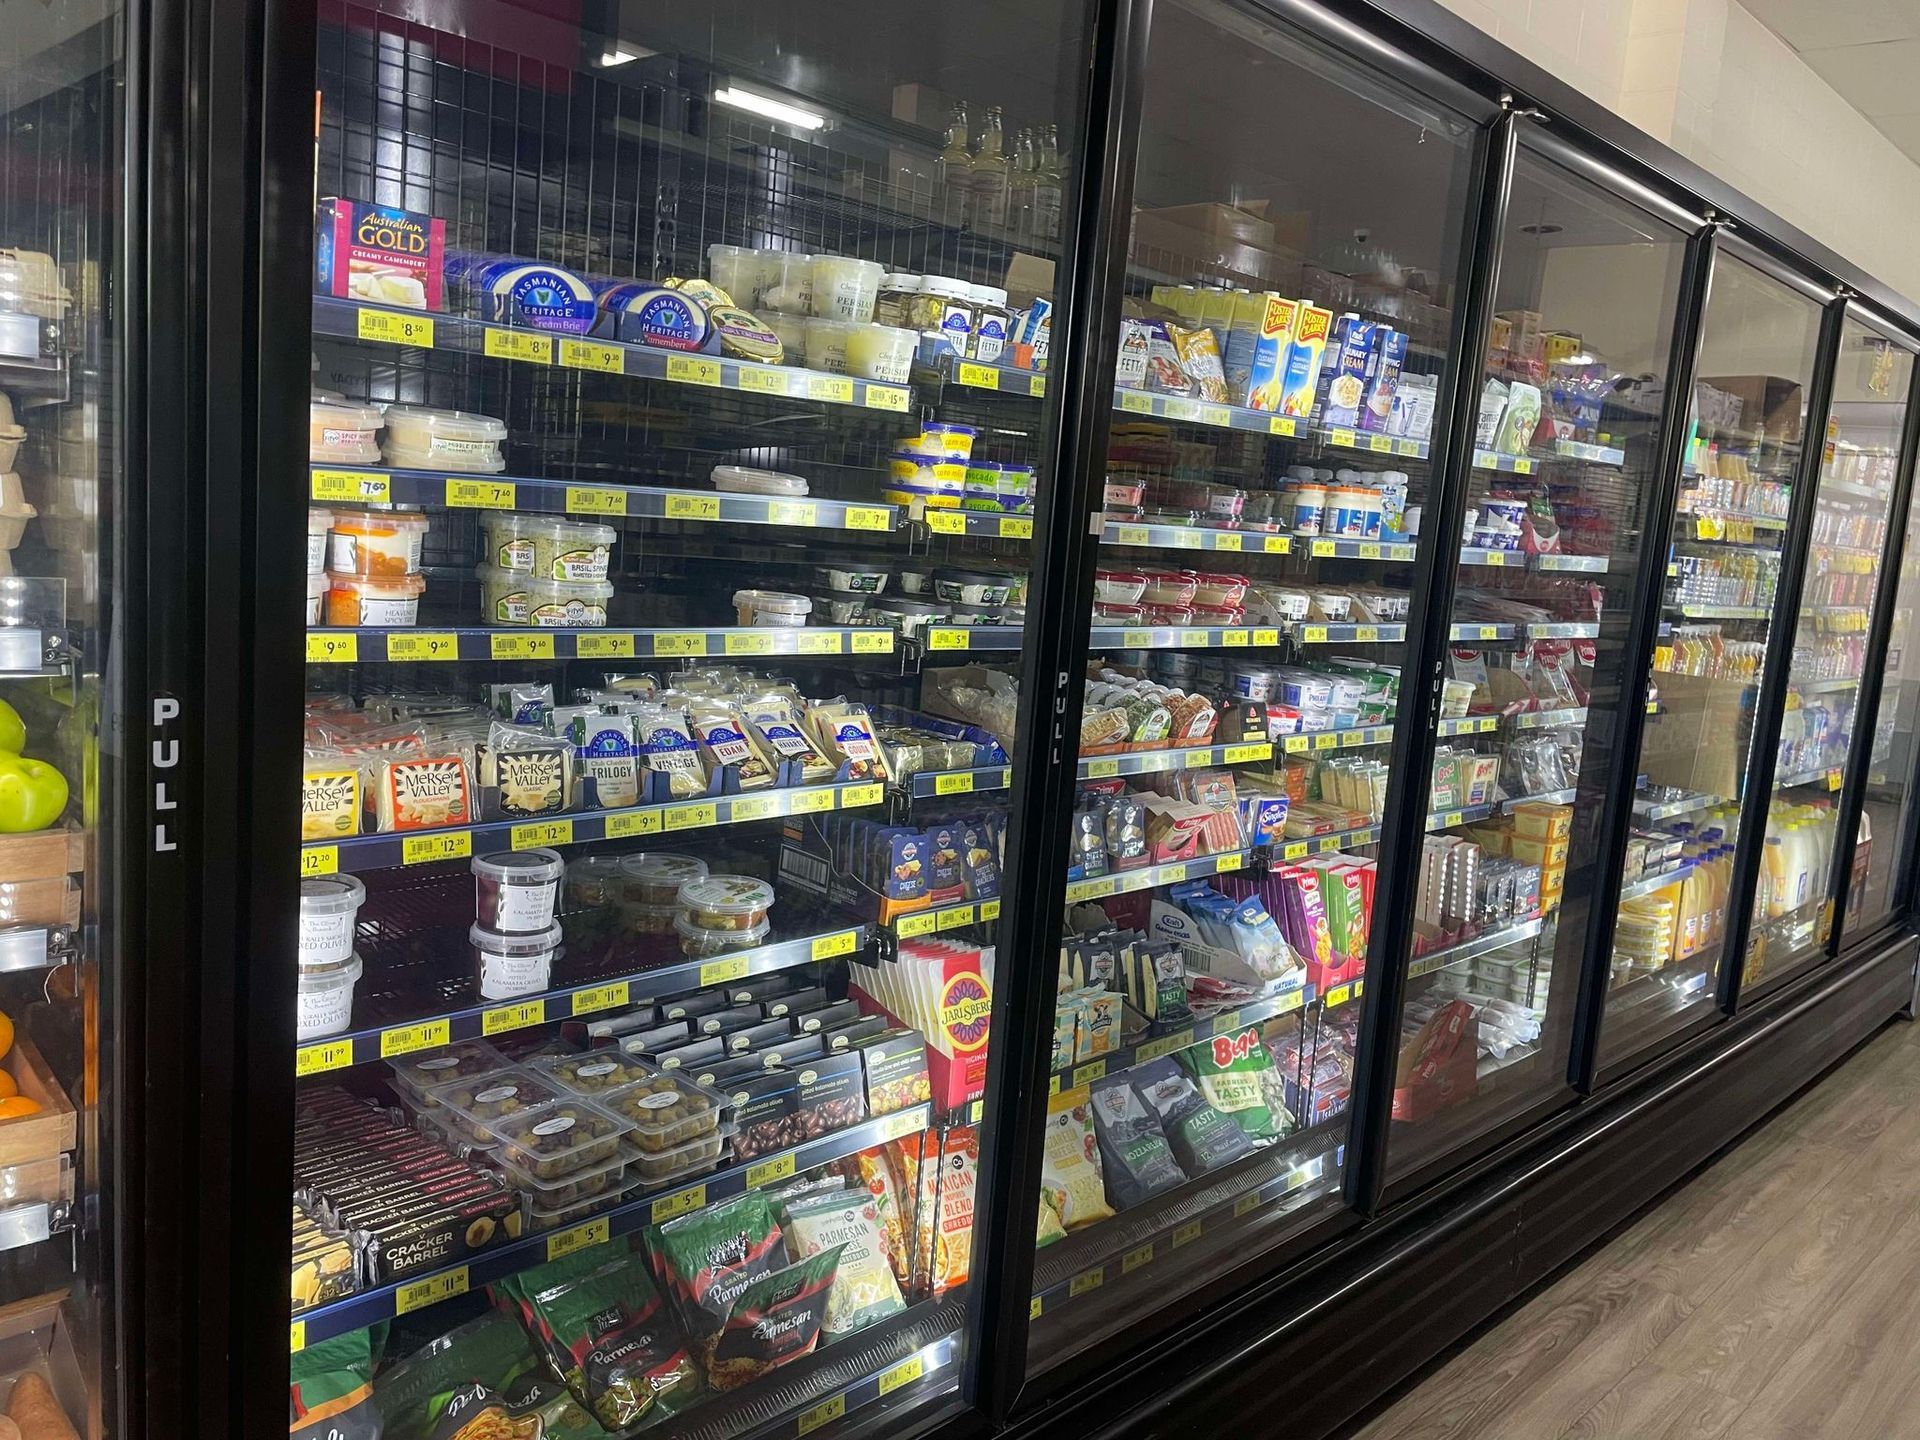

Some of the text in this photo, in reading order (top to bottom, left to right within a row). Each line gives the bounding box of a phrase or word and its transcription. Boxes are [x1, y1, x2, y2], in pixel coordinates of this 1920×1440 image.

[362, 212, 423, 233] Australian
[358, 225, 425, 253] GOLD
[352, 249, 427, 268] CREAMY CAMEMBERT
[515, 275, 572, 306] TASMANIAN
[644, 300, 691, 328] TASMANIAN
[401, 322, 424, 338] $8.50
[563, 319, 582, 331] Brie
[642, 322, 690, 339] HERITAGE
[982, 341, 999, 353] FETTA
[324, 641, 347, 654] $9.60
[427, 641, 449, 653] $9.60
[527, 640, 546, 652] $9.60
[609, 640, 626, 651] $9.60
[1429, 661, 1442, 729] PULL
[1053, 672, 1069, 764] PULL
[718, 745, 743, 757] EDAM
[153, 698, 180, 852] PULL
[591, 766, 632, 779] TRILOGY
[1263, 810, 1287, 823] Singles
[544, 827, 567, 839] $12.20
[441, 838, 465, 852] $12.20
[320, 939, 347, 950] OLIVES
[604, 989, 623, 1002] $11.99
[1161, 991, 1181, 1001] TASTY
[323, 1010, 348, 1024] OLIVES
[517, 1007, 538, 1020] $11.99
[941, 999, 992, 1025] JARLSBERG
[420, 1027, 443, 1040] $11.99
[1212, 1028, 1259, 1069] Bega
[321, 1050, 345, 1063] $11.99
[837, 1078, 850, 1087] olives
[1215, 1086, 1256, 1099] TASTY
[1188, 1108, 1217, 1130] TASTY
[353, 1159, 388, 1172] BARREL
[361, 1170, 398, 1184] BARREL
[928, 1172, 973, 1195] MXICAN
[377, 1179, 413, 1194] BARREL
[386, 1175, 473, 1206] BARREL Extra Sharp
[401, 1201, 438, 1216] BARREL
[445, 1192, 465, 1202] Extra
[466, 1184, 490, 1198] Sharp
[944, 1198, 973, 1217] BLEND
[421, 1214, 459, 1229] BARREL
[819, 1223, 869, 1247] PARMESAN
[386, 1231, 453, 1261] CRACKER
[393, 1246, 449, 1271] BARREL
[443, 1275, 465, 1292] $11.30
[709, 1268, 772, 1305] Parmesan
[752, 1309, 812, 1340] Parmesan
